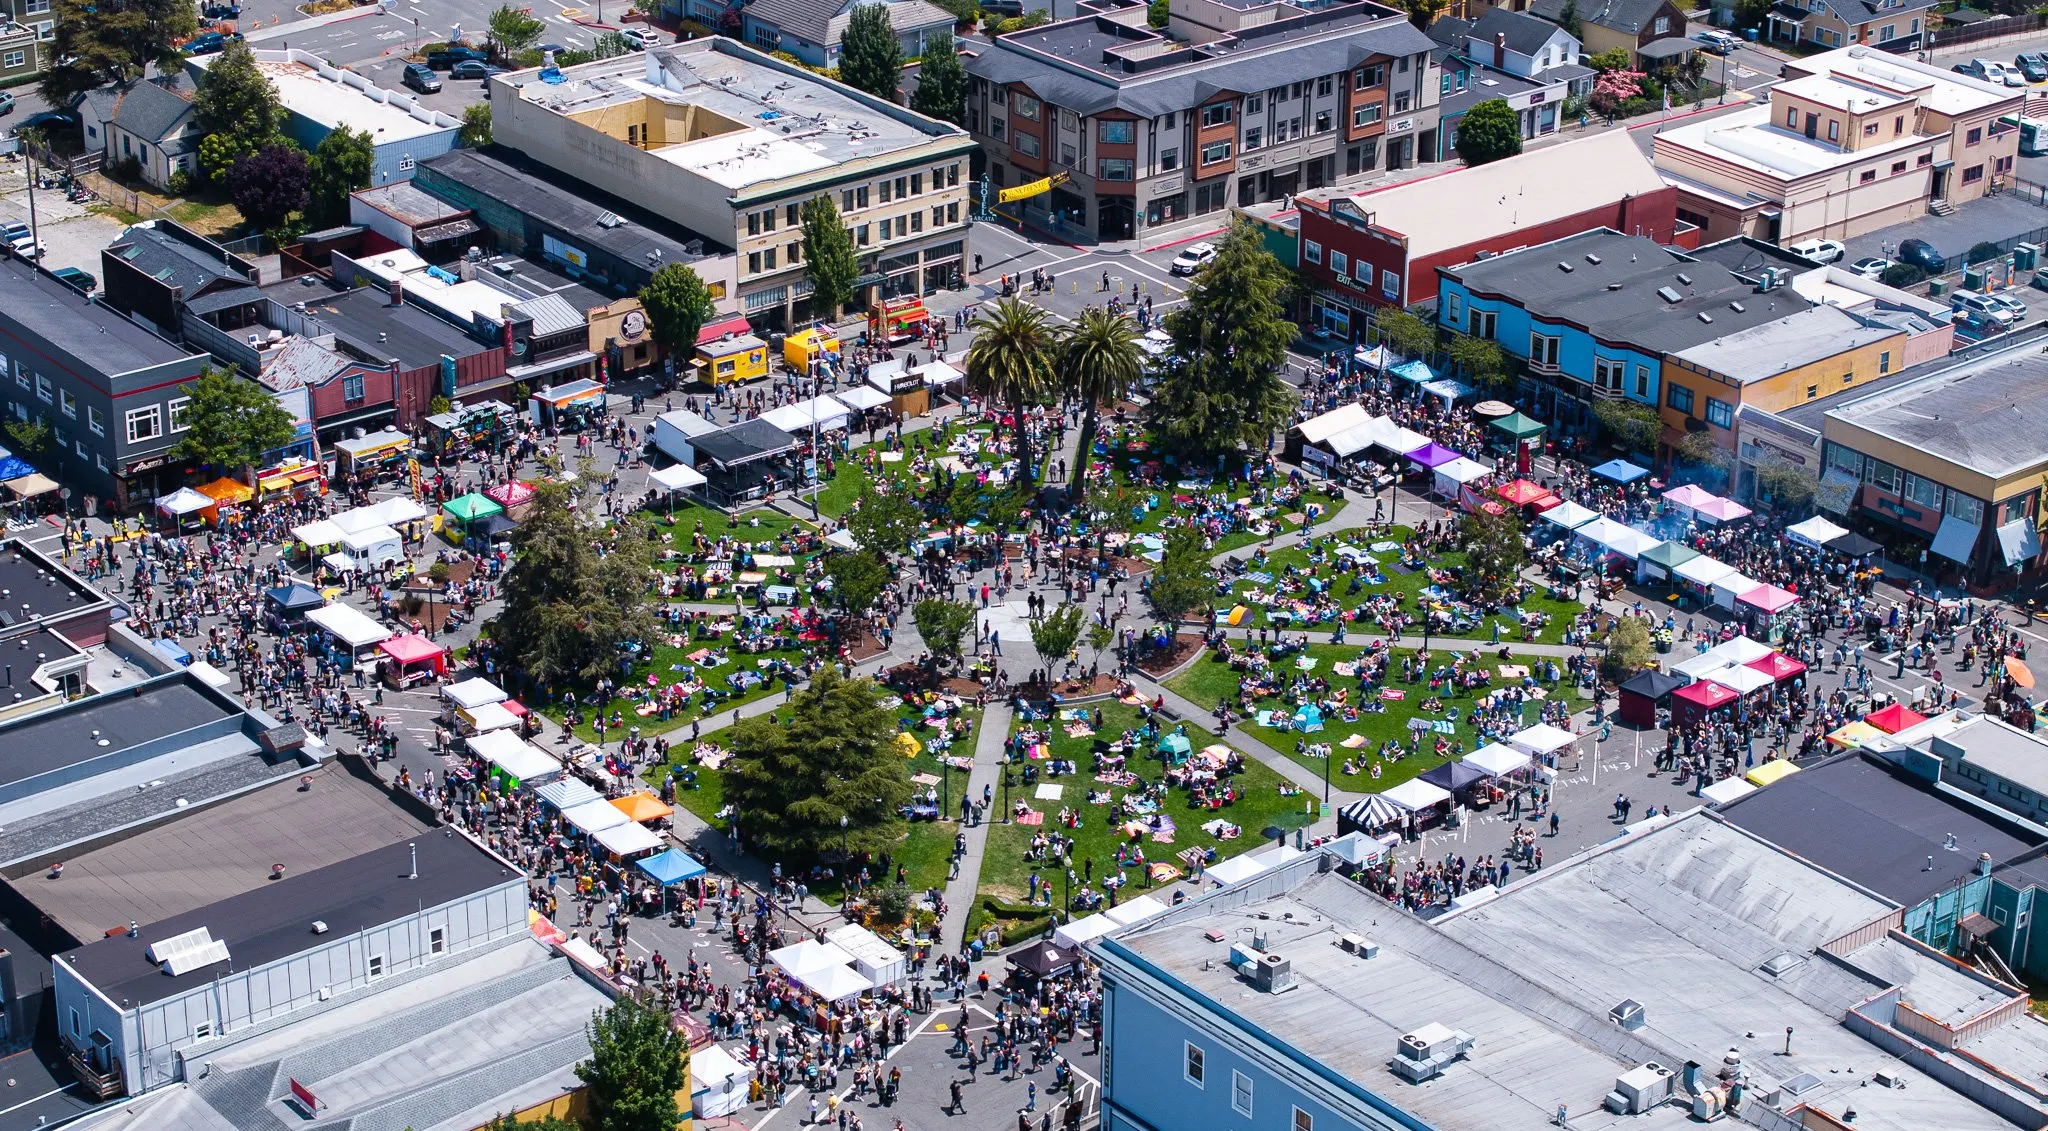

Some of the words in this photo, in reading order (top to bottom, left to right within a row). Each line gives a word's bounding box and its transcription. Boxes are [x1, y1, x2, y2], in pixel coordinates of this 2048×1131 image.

[980, 182, 988, 216] HOTEL
[1336, 273, 1352, 286] EXIT
[1349, 281, 1366, 293] Theatre
[894, 378, 920, 390] HUMBOLDT
[1602, 762, 1631, 773] 143
[1562, 776, 1590, 788] 144
[1431, 832, 1458, 846] 147
